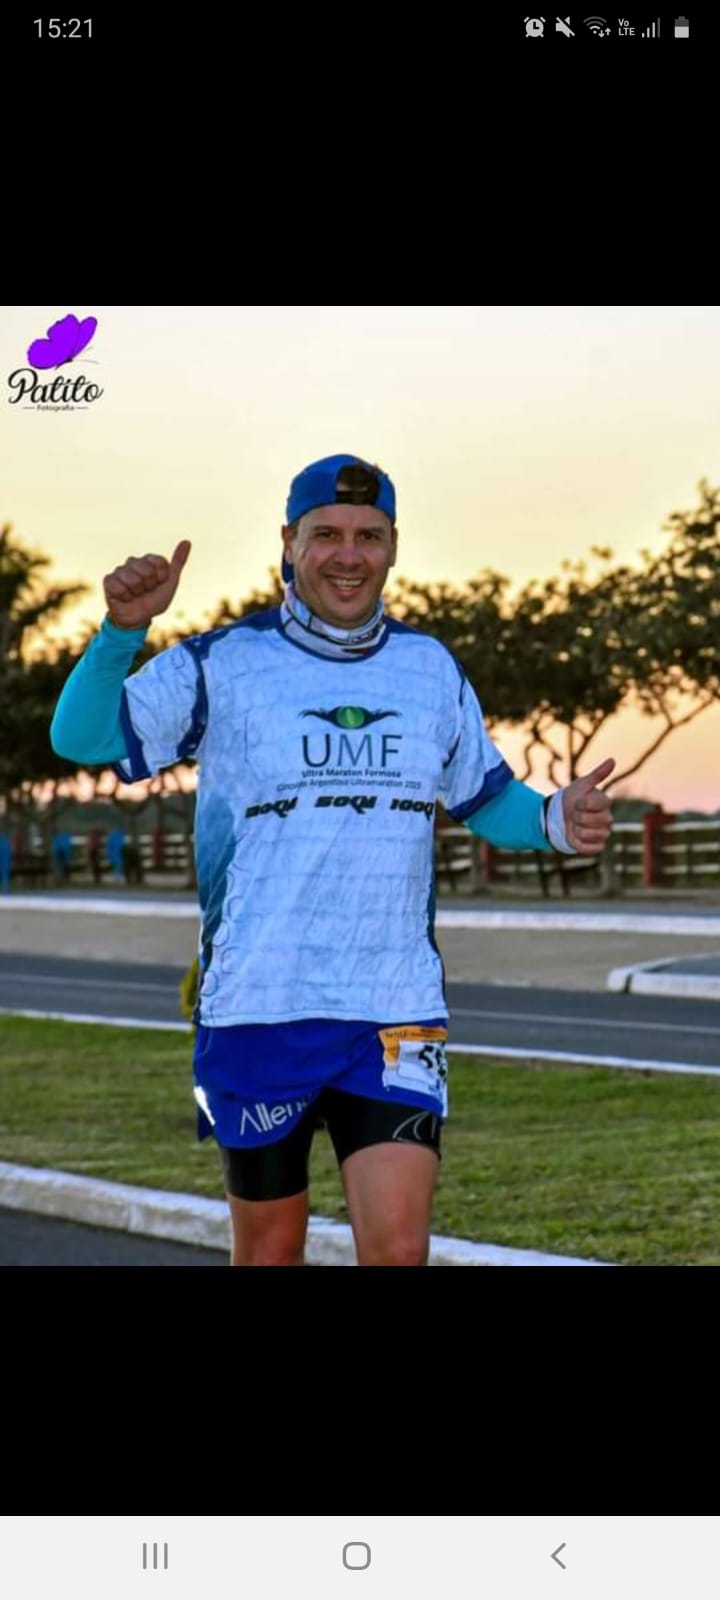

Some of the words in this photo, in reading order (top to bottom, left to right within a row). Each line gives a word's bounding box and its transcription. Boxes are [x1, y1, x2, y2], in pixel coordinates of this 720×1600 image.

[302, 733, 402, 768] UMF
[302, 769, 324, 778] Ultra
[364, 768, 401, 778] Formosa
